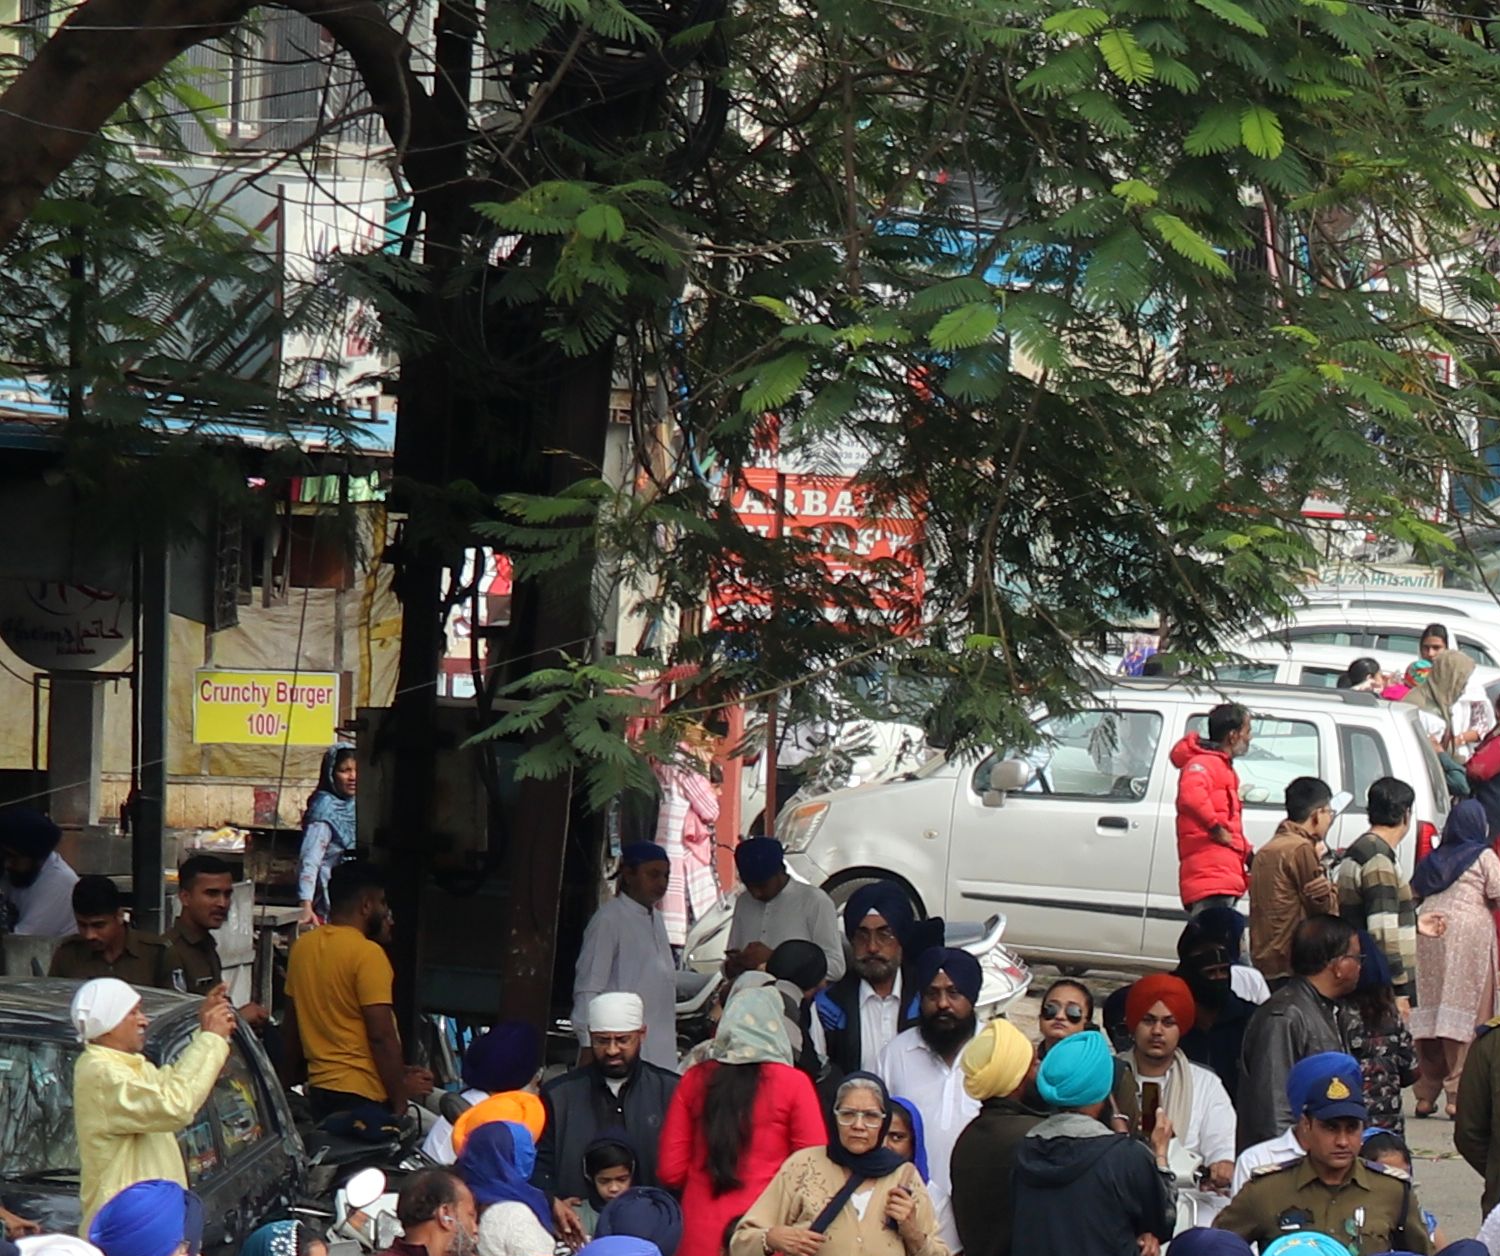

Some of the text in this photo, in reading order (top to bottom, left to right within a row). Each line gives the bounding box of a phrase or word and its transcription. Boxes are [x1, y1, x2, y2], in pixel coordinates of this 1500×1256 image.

[200, 680, 333, 709] Crunchy Burger
[247, 713, 287, 736] 100/-
